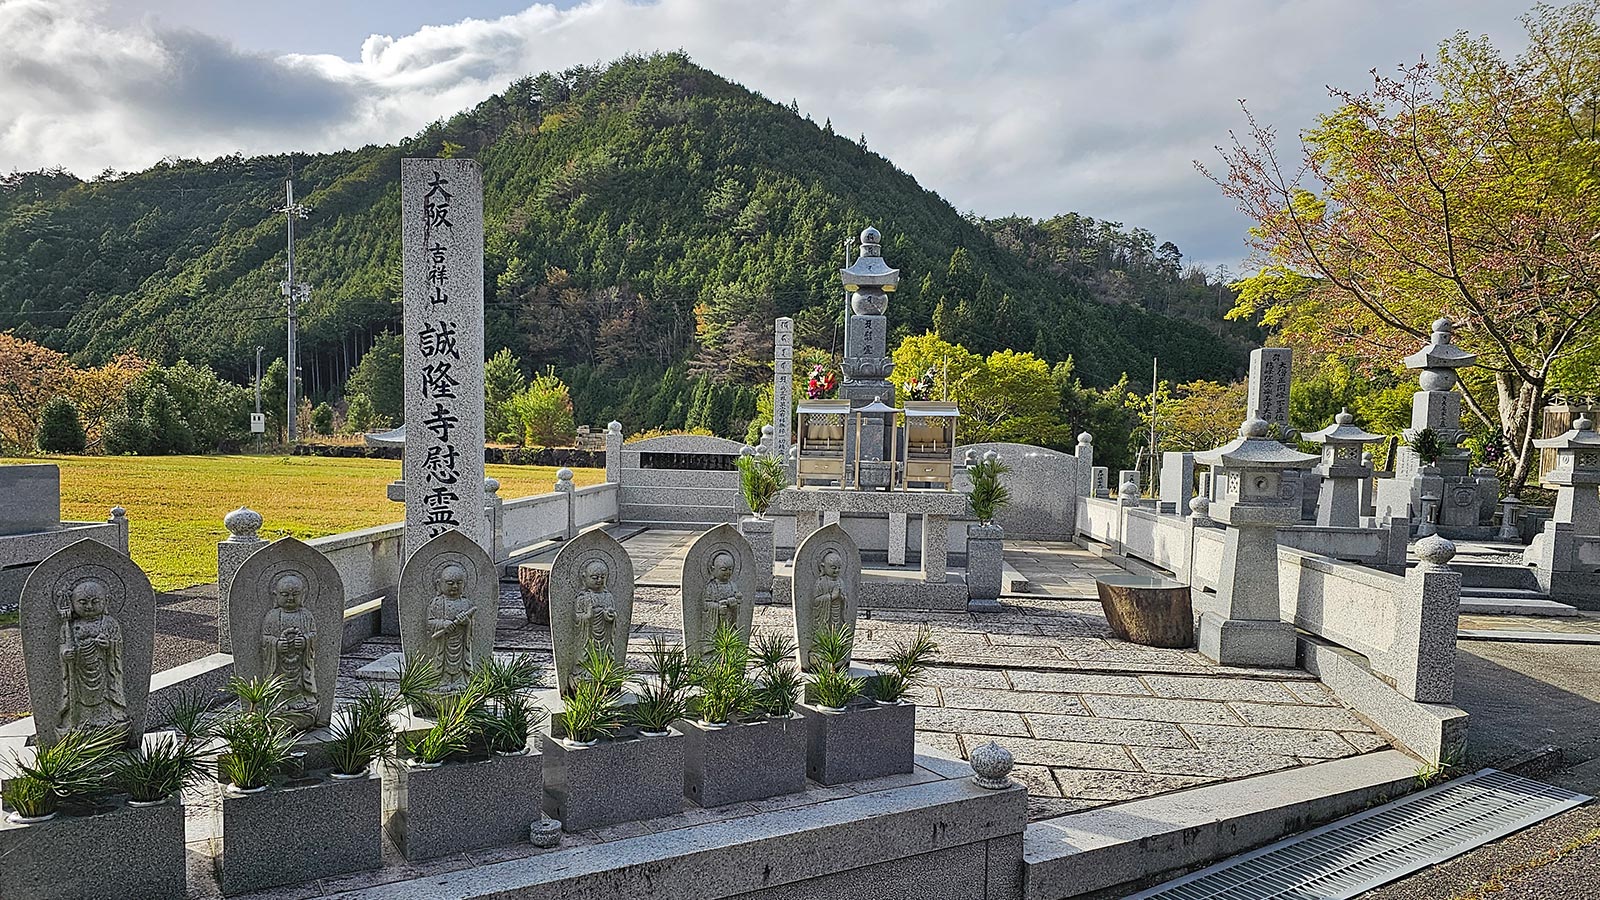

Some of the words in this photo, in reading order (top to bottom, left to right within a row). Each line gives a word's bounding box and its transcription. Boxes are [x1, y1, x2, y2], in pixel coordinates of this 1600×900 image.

[425, 171, 453, 229] 大阪
[427, 242, 449, 304] 吉祥山
[418, 320, 461, 539] 誠隆寺慰霊
